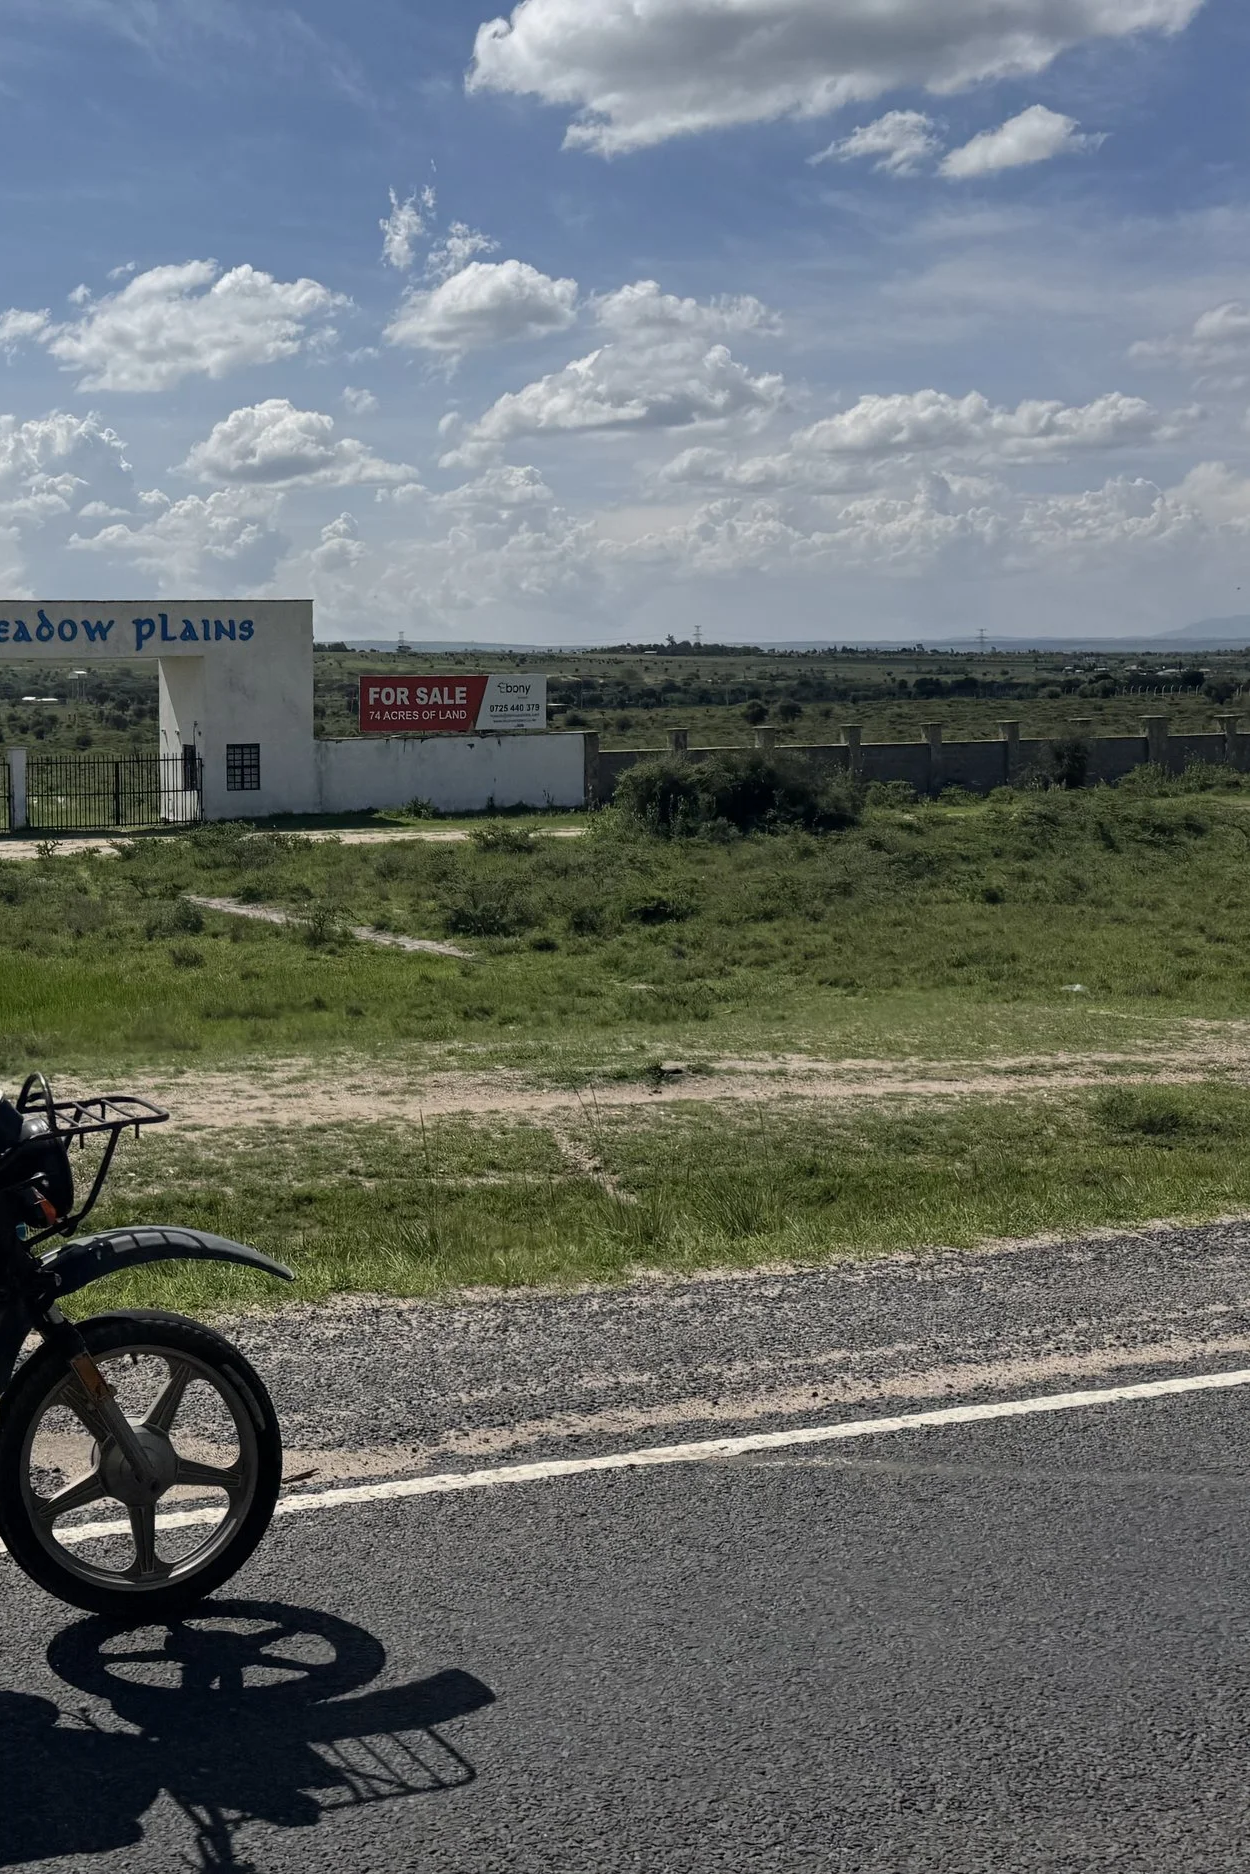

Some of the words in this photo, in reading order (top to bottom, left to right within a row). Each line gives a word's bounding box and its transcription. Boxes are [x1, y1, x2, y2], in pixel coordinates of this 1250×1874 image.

[368, 687, 410, 706] FOR
[415, 686, 467, 705] SALE
[489, 704, 509, 713] 0725
[510, 703, 524, 712] 440
[369, 711, 381, 720] 74
[382, 710, 420, 720] ACRES
[422, 710, 436, 720] OF
[439, 710, 467, 720] LAND
